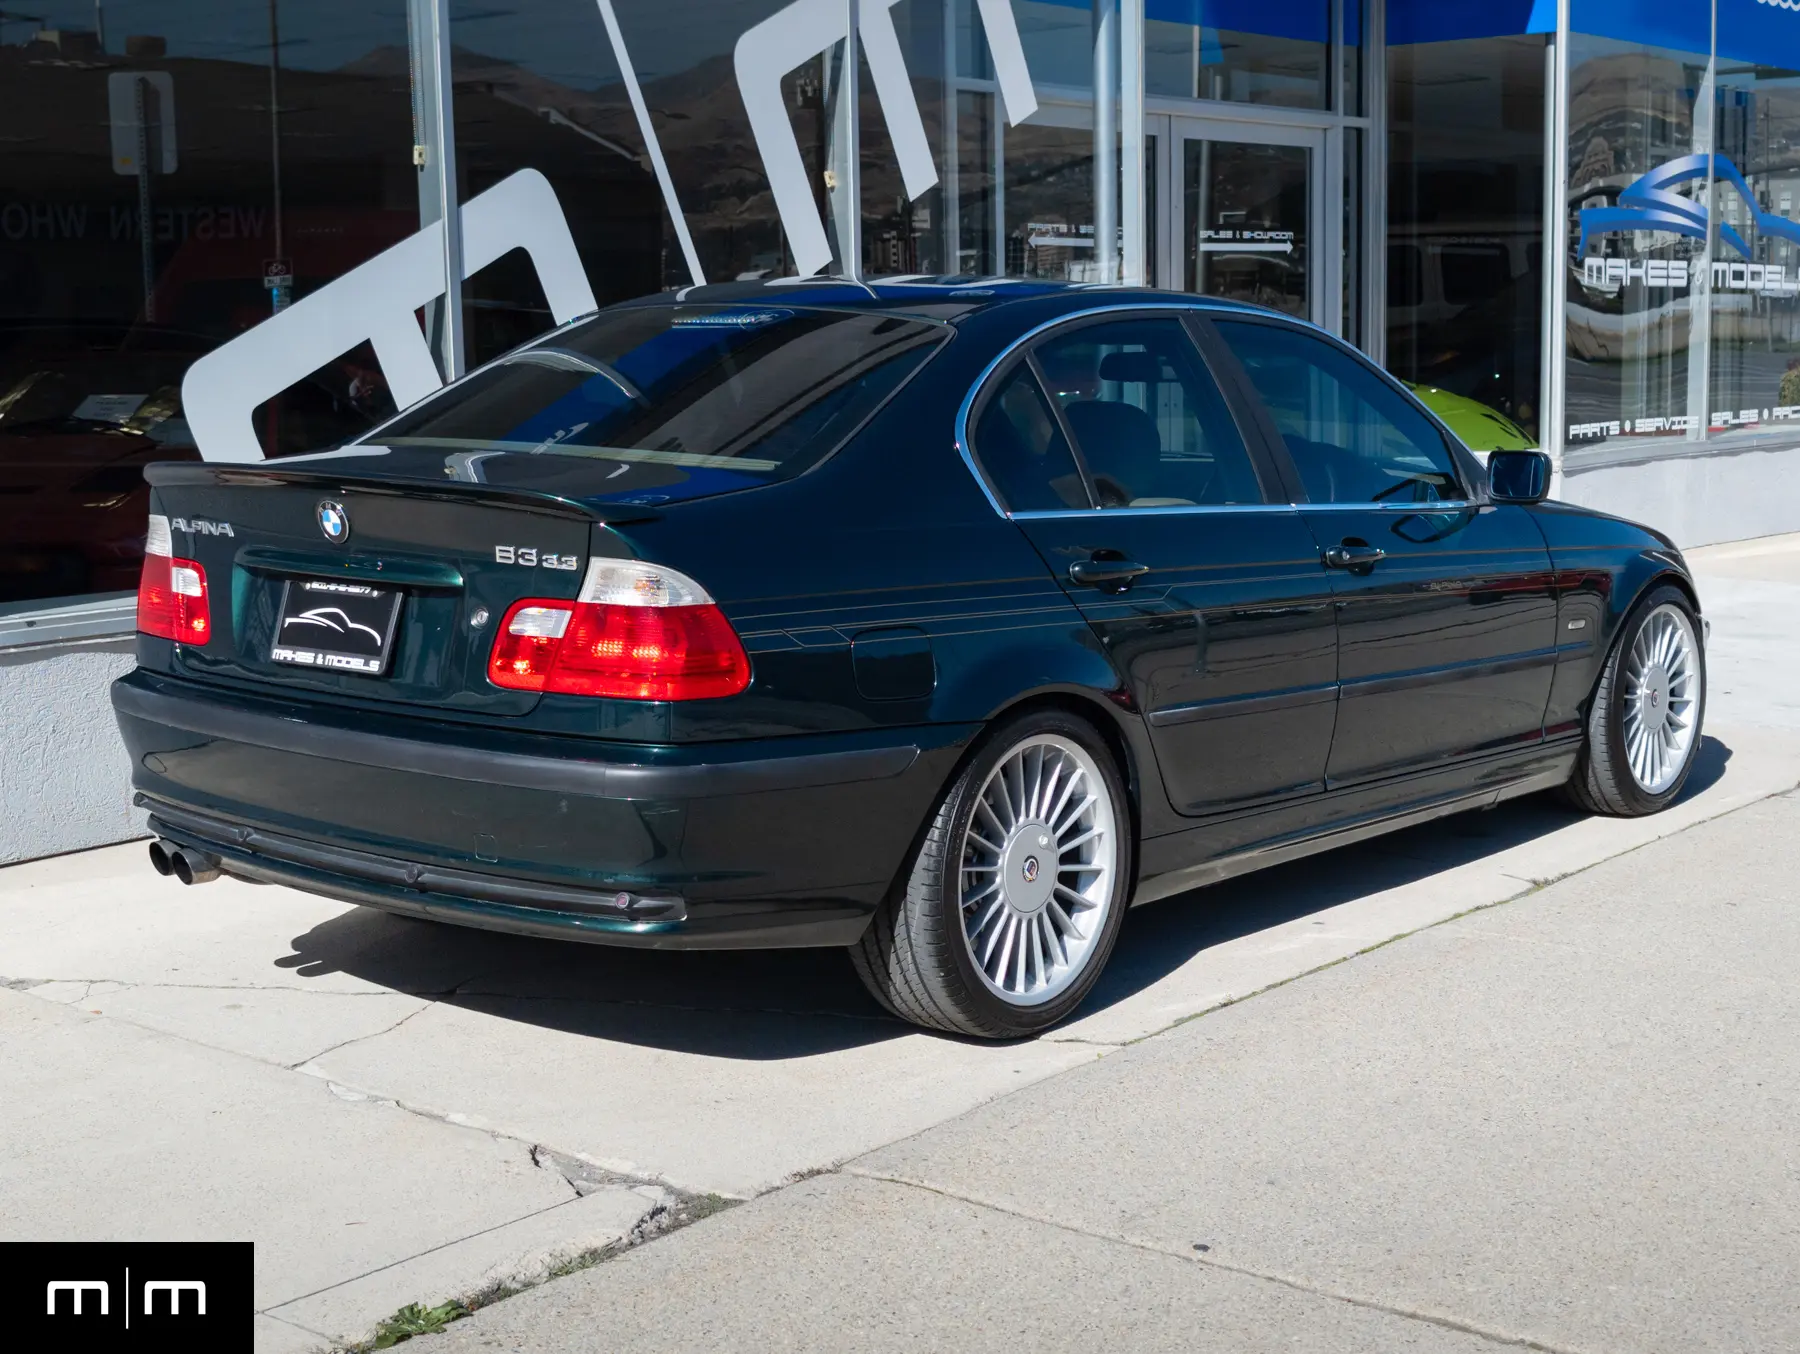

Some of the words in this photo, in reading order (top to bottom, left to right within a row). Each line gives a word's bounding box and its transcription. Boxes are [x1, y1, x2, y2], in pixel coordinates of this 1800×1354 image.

[1027, 223, 1068, 233] PARTS
[1199, 230, 1233, 239] SALES
[1242, 231, 1294, 240] SHOWROOM
[1584, 256, 1688, 287] MAKES
[1711, 262, 1800, 290] MODEL
[1569, 420, 1620, 440] PARTS
[1634, 415, 1699, 434] SERVICE
[1711, 408, 1759, 427] SALES
[171, 515, 235, 538] ALPINA
[495, 543, 538, 567] B3
[272, 648, 316, 664] MAKES
[316, 653, 324, 665] &
[325, 654, 381, 672] MODELS
